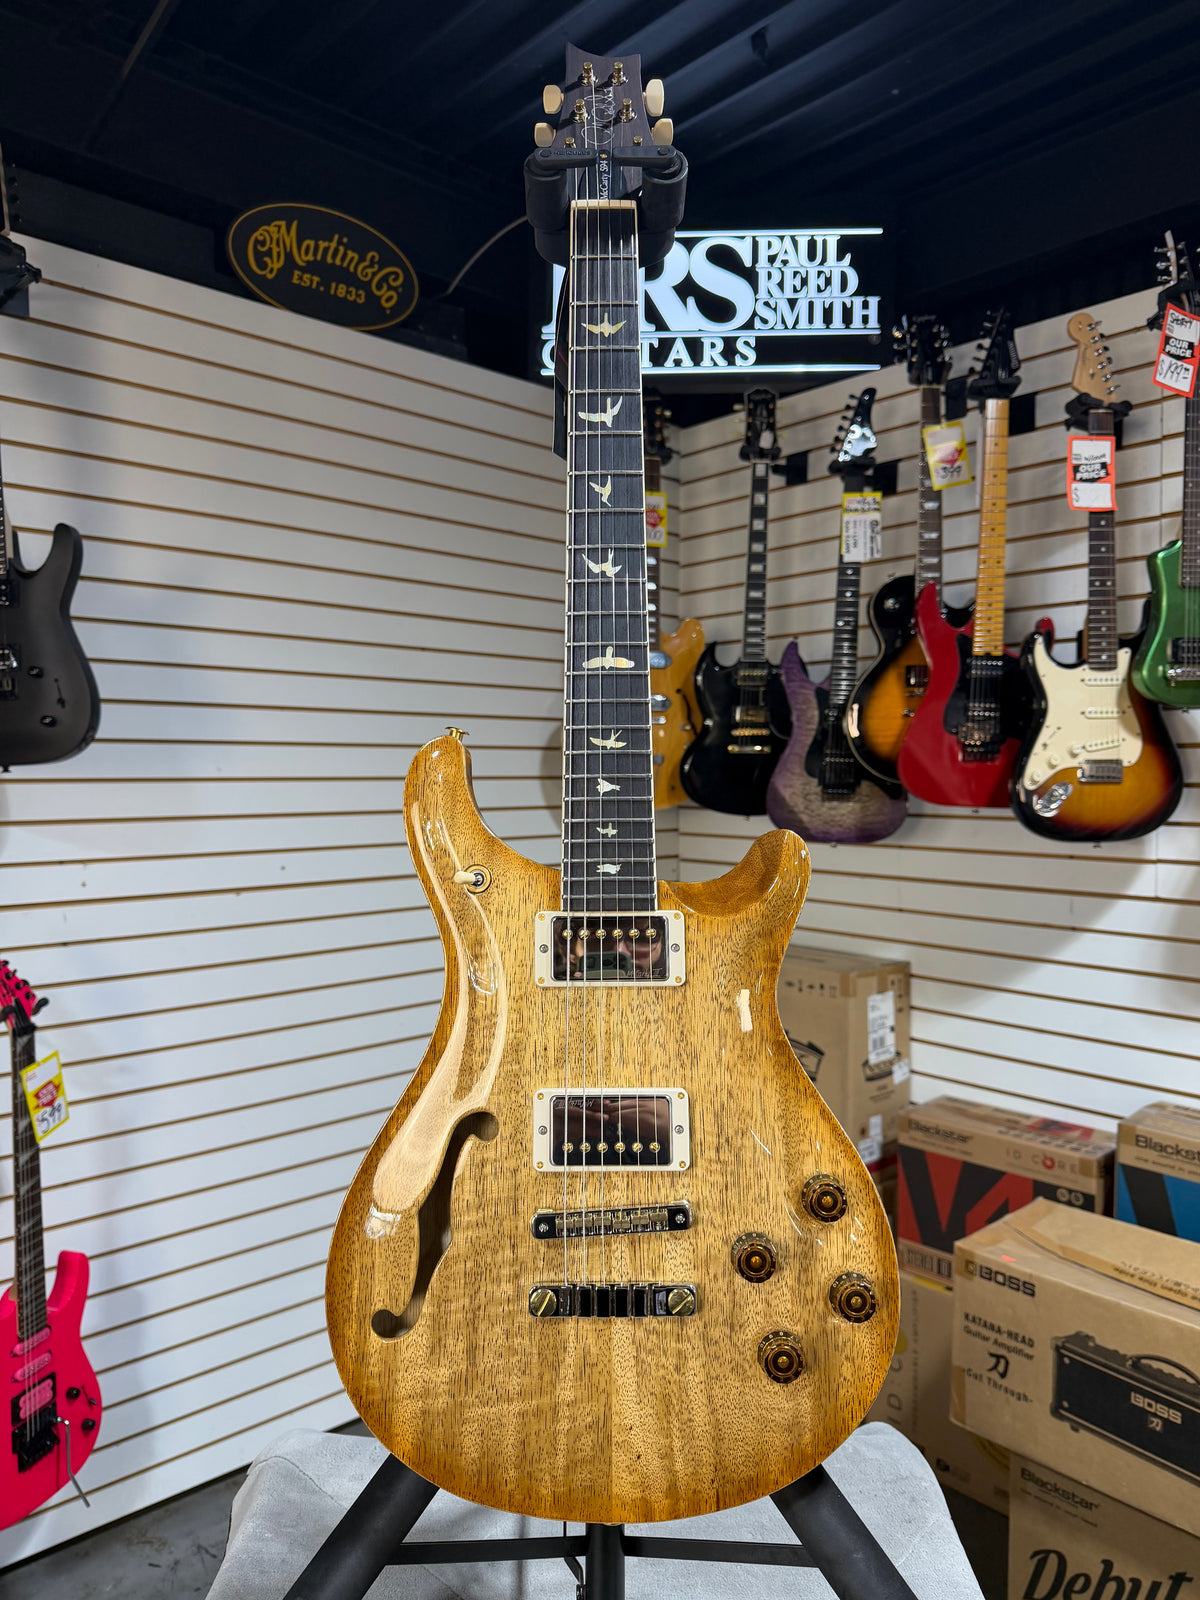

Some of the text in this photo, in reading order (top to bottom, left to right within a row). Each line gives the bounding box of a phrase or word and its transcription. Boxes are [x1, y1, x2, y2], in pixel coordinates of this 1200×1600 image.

[755, 235, 852, 268] PAUL
[291, 270, 324, 292] EST.
[329, 282, 366, 304] 1833
[541, 235, 758, 333] RS
[756, 266, 860, 299] REED
[754, 296, 882, 330] SMITH
[1165, 344, 1193, 358] PRICE
[1169, 338, 1189, 350] OUR
[1075, 468, 1107, 481] PRICE
[1079, 463, 1102, 474] OUR
[907, 1118, 974, 1144] Blackstar
[978, 1263, 1036, 1298] BOSS
[1130, 1391, 1182, 1425] BOSS
[1020, 1466, 1100, 1512] Blackstar
